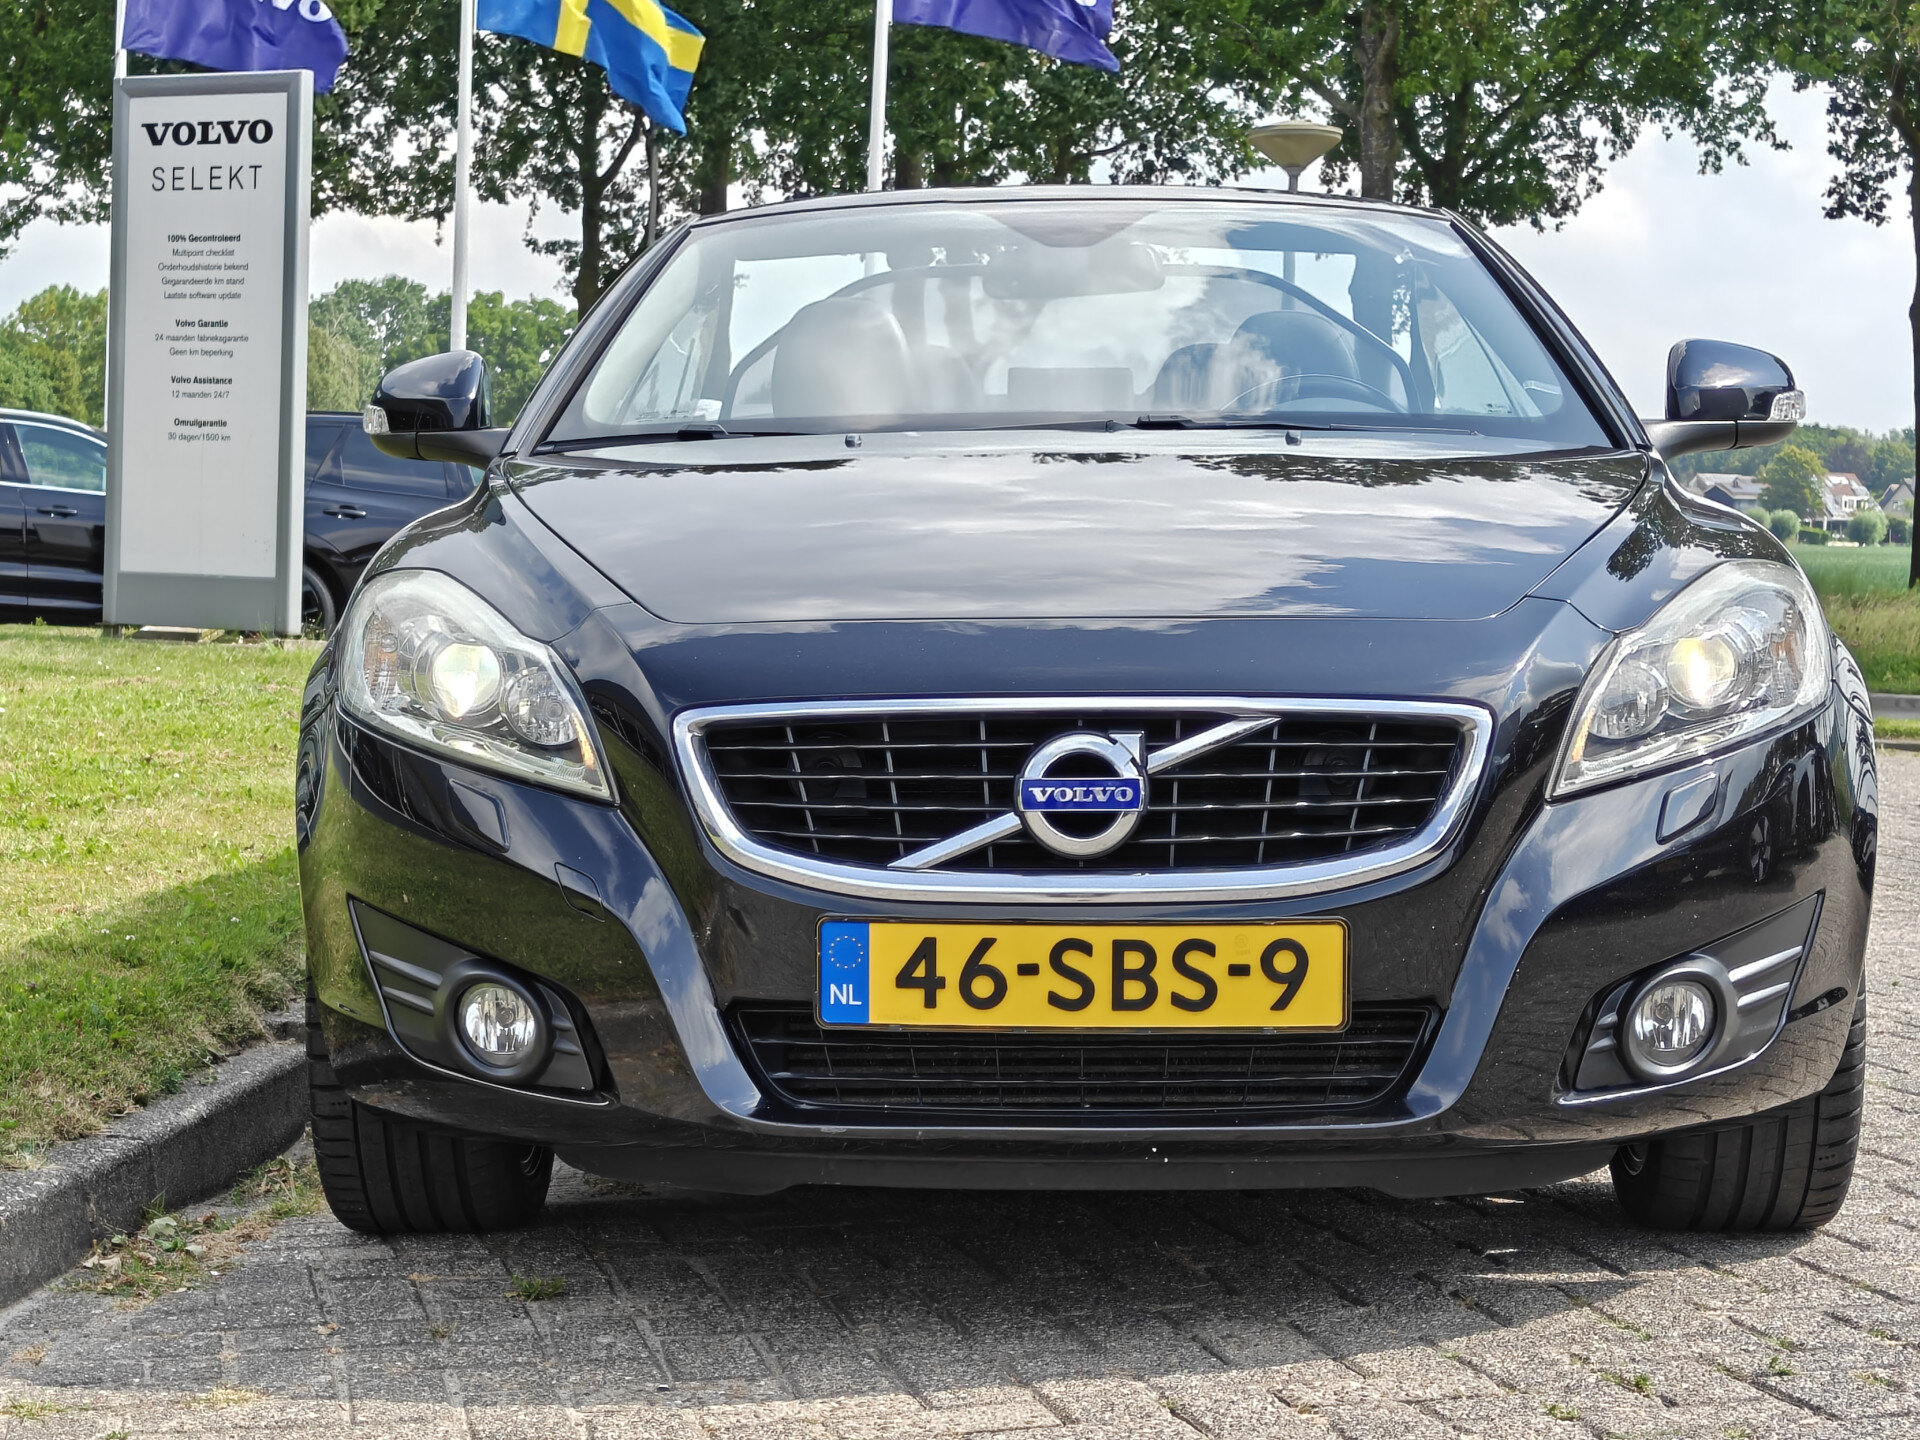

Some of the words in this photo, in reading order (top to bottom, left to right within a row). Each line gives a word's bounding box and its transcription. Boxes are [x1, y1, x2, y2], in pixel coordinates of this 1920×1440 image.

[141, 119, 273, 146] VOLVO
[152, 165, 262, 192] SELEKT
[167, 234, 187, 243] 100%
[188, 233, 241, 243] Gecontroleerd
[172, 248, 204, 258] Multipoint
[205, 248, 235, 257] checklist
[157, 262, 222, 271] Onderhoudshistorie
[223, 262, 249, 271] bekend
[161, 276, 213, 287] Gegarandeerde
[214, 277, 225, 285] km
[225, 276, 245, 285] stand
[163, 291, 187, 299] Laatste
[188, 291, 217, 299] software
[218, 291, 242, 301] update
[175, 319, 196, 328] Volvo
[197, 319, 229, 328] Garantie
[154, 333, 164, 341] 24
[165, 333, 196, 341] maanden
[197, 333, 249, 344] fabrieksgarantie
[169, 347, 188, 356] Geen
[189, 347, 200, 356] km
[200, 348, 234, 358] beperking
[170, 376, 192, 384] Volvo
[192, 376, 233, 385] Assistance
[171, 390, 180, 398] 12
[181, 390, 212, 399] maanden
[213, 390, 230, 398] 24/7
[173, 418, 228, 428] Omruilgarantie
[167, 432, 177, 440] 30
[220, 433, 232, 441] km
[1028, 786, 1134, 802] VOLVO
[895, 936, 1310, 1012] 46-SBS-9
[829, 983, 862, 1006] NL
